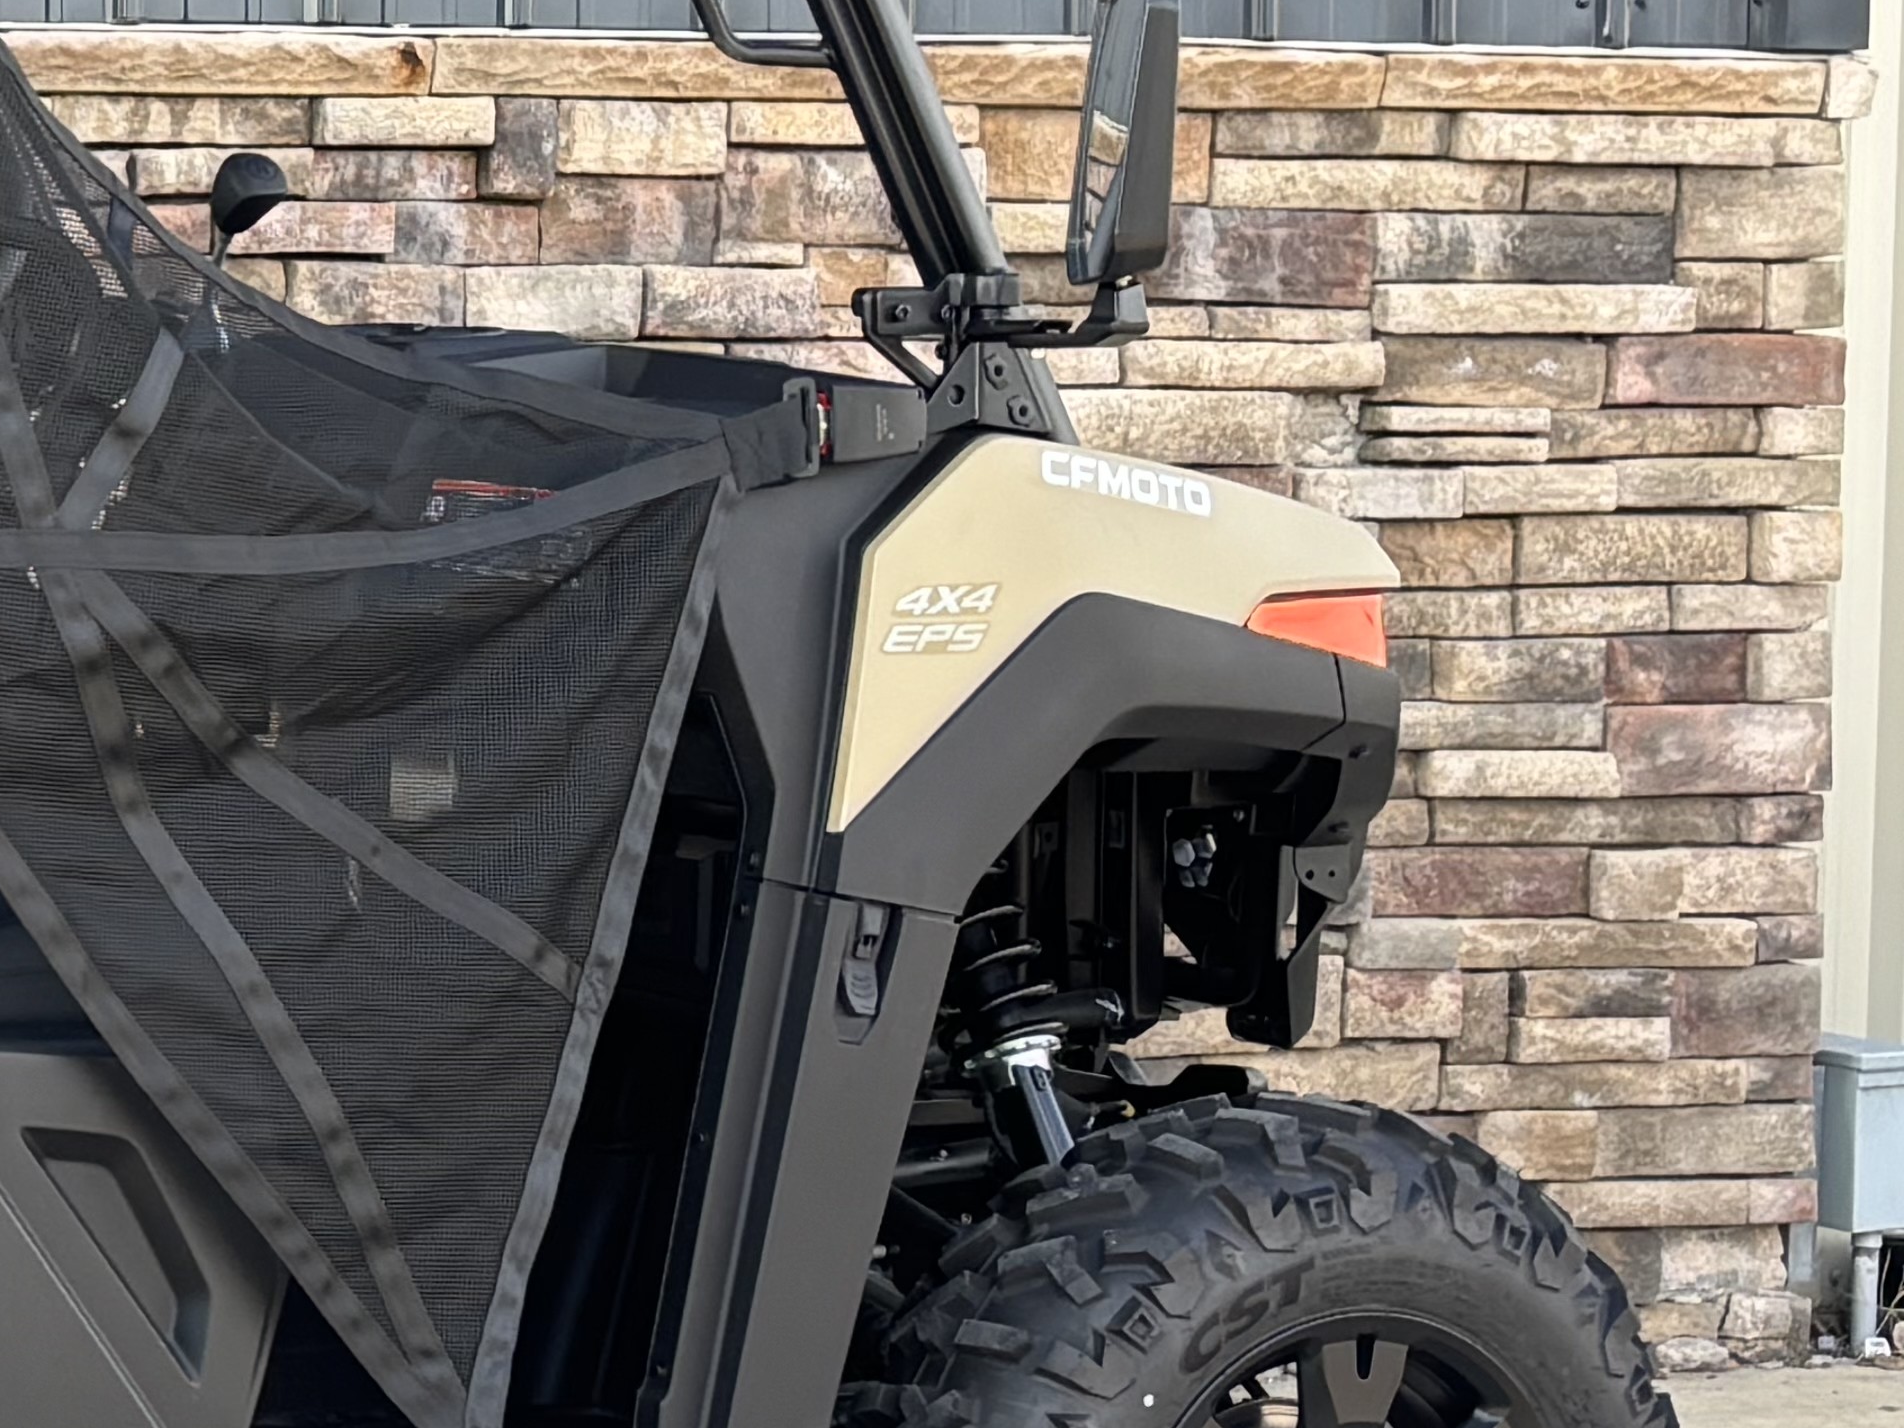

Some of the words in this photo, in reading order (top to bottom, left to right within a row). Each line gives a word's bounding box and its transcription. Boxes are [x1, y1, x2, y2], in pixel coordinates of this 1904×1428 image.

[1040, 450, 1212, 517] CFMOTO
[896, 585, 996, 615] 4X4
[883, 623, 986, 653] EPS
[1183, 1259, 1314, 1373] CST
